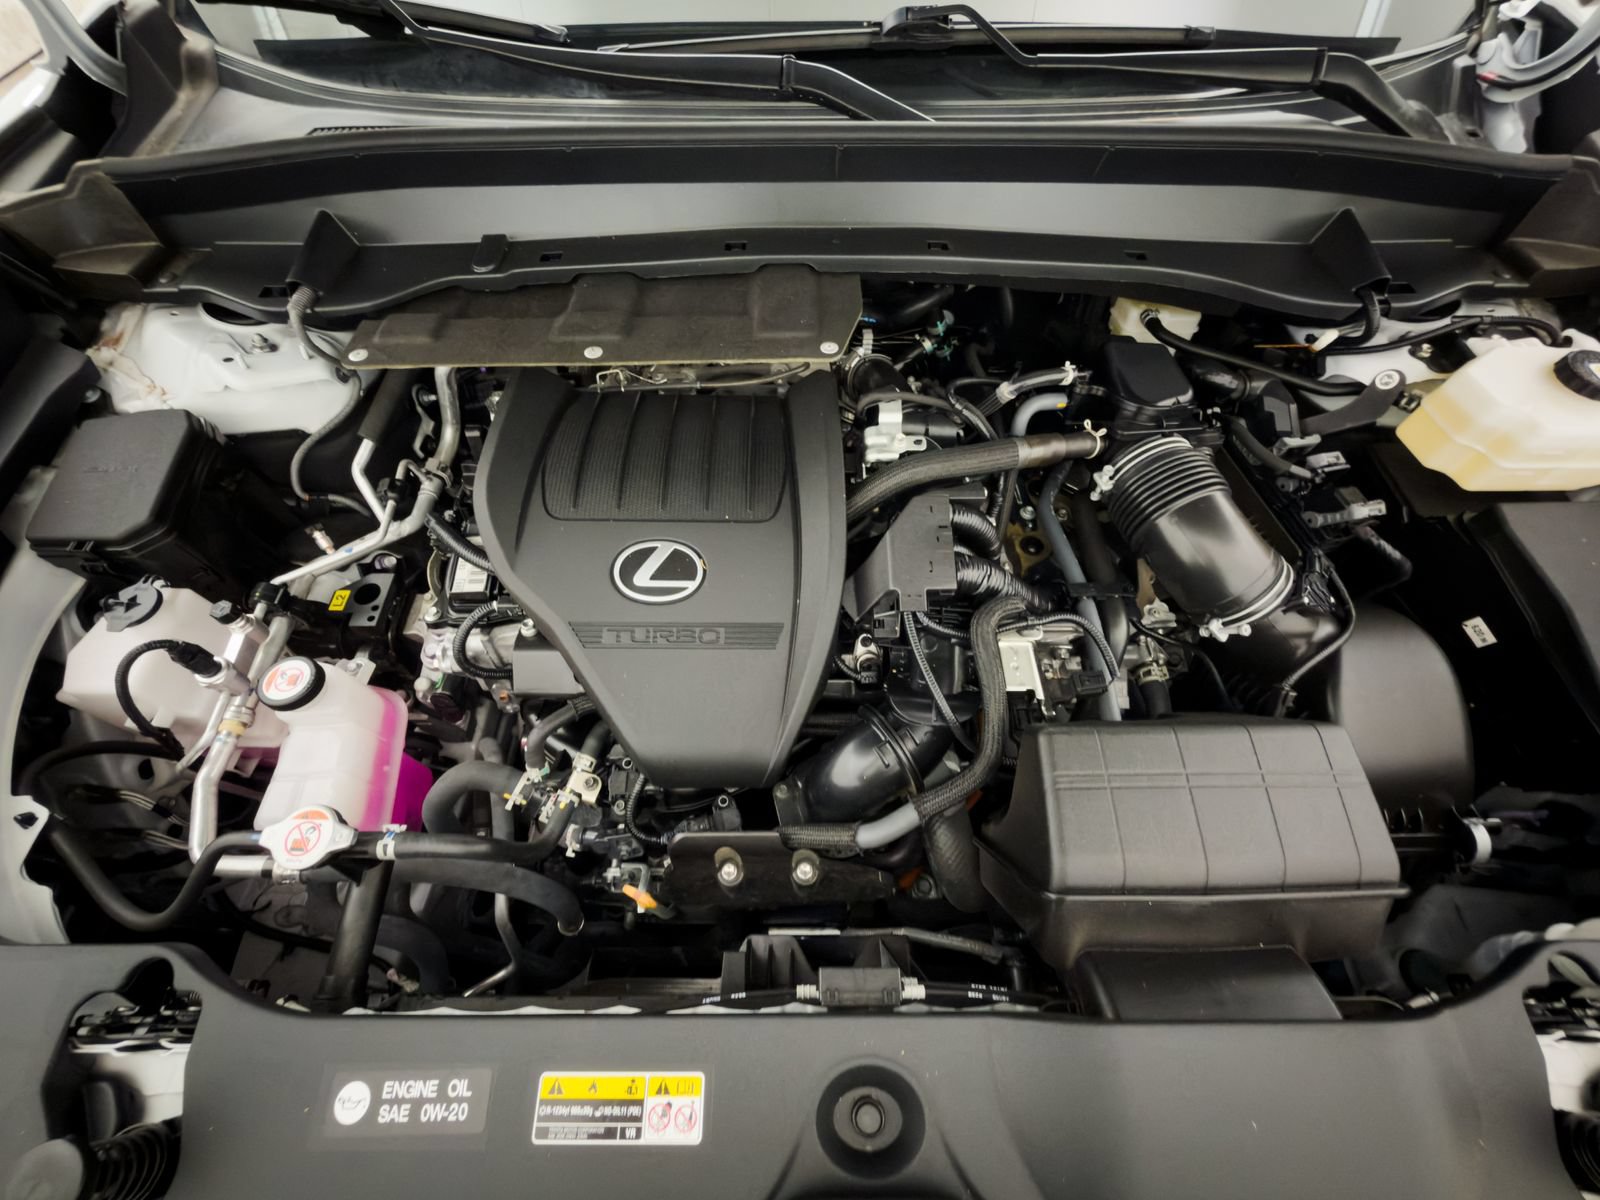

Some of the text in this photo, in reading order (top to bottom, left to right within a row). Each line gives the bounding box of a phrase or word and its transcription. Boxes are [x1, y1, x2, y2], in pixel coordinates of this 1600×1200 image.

[333, 594, 347, 607] L2
[605, 627, 720, 645] TURBO
[381, 1078, 472, 1099] ENGINE OIL
[377, 1102, 469, 1124] SAE 0W-20
